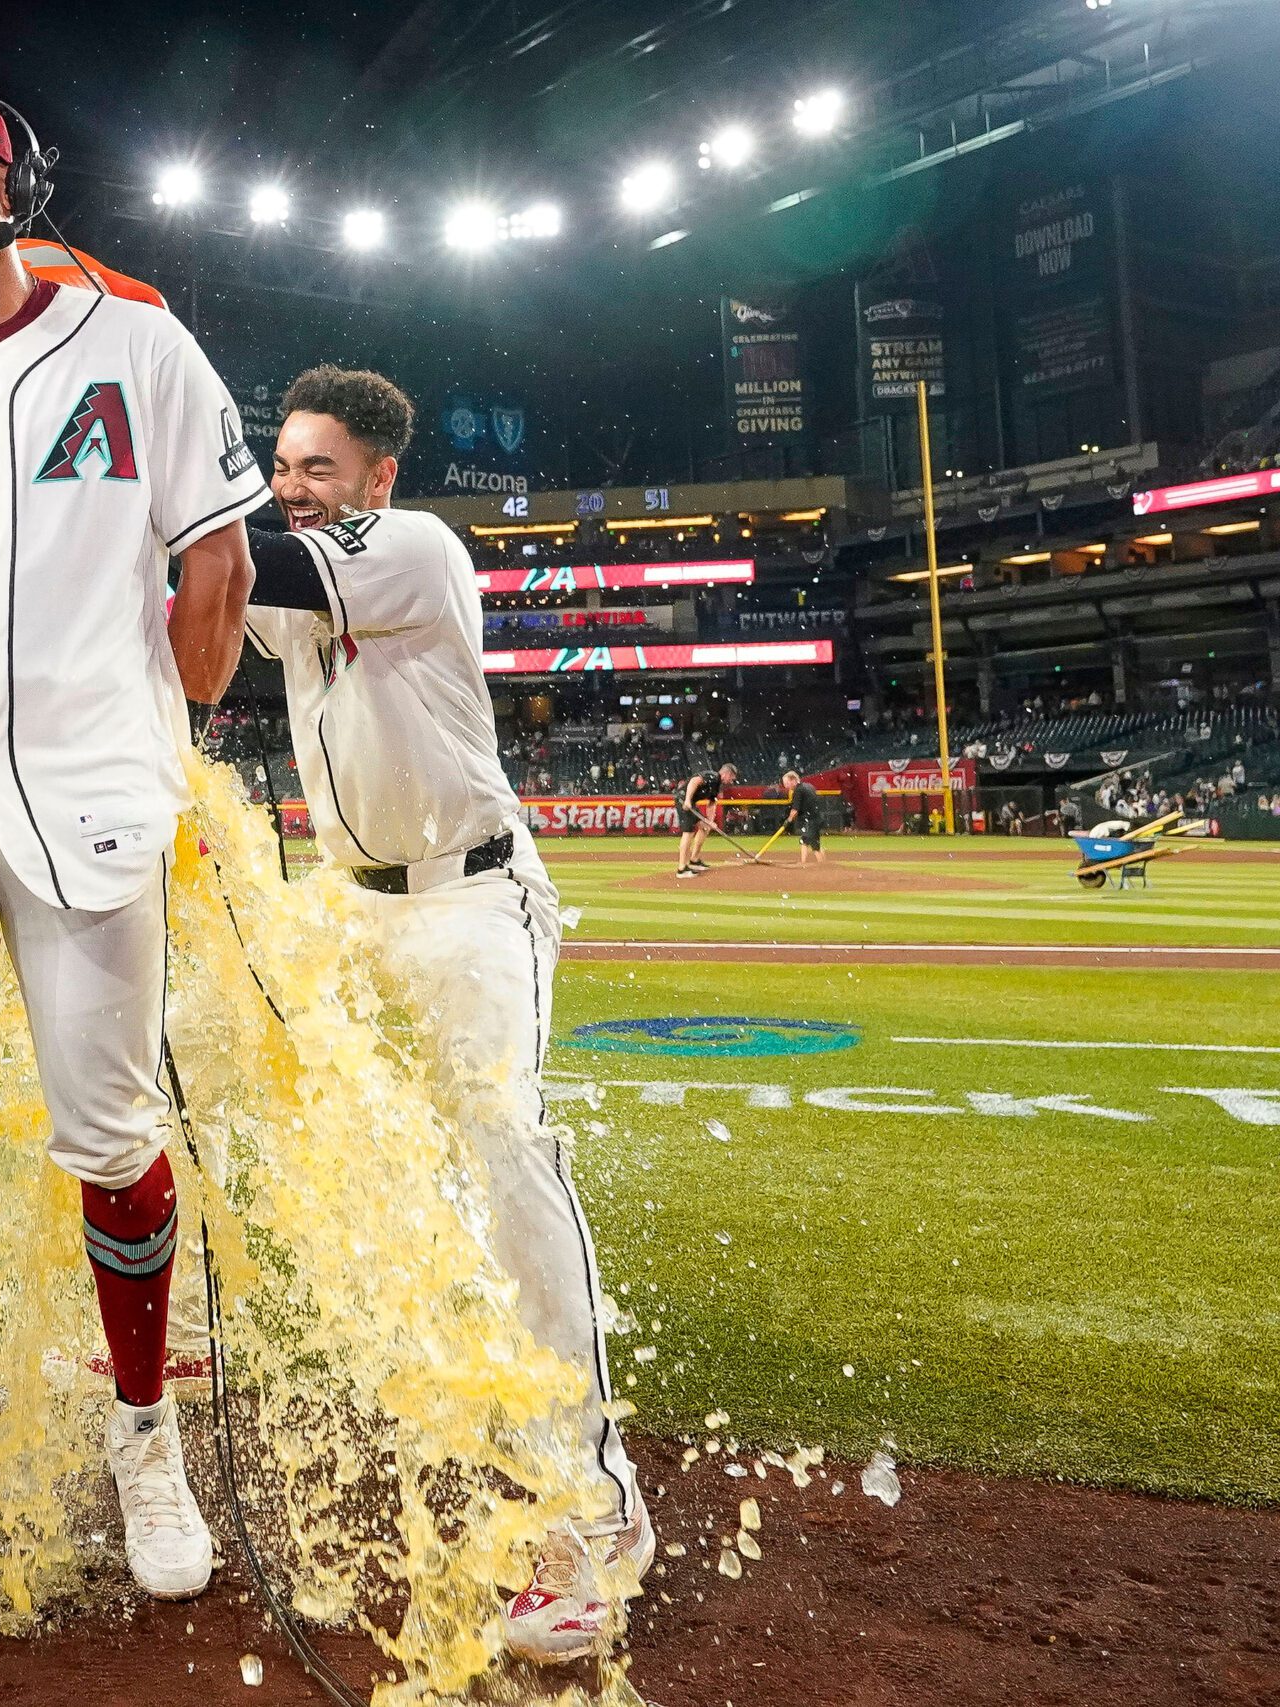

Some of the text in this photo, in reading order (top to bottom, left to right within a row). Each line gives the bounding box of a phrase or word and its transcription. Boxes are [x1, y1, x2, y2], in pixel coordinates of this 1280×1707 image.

[1039, 246, 1071, 276] NOW
[871, 340, 943, 356] STREAM
[735, 380, 801, 395] MILLION
[737, 417, 803, 433] GIVING
[444, 463, 528, 494] Arizona
[502, 496, 529, 517] 42
[576, 491, 605, 513] 20
[644, 488, 670, 511] 51
